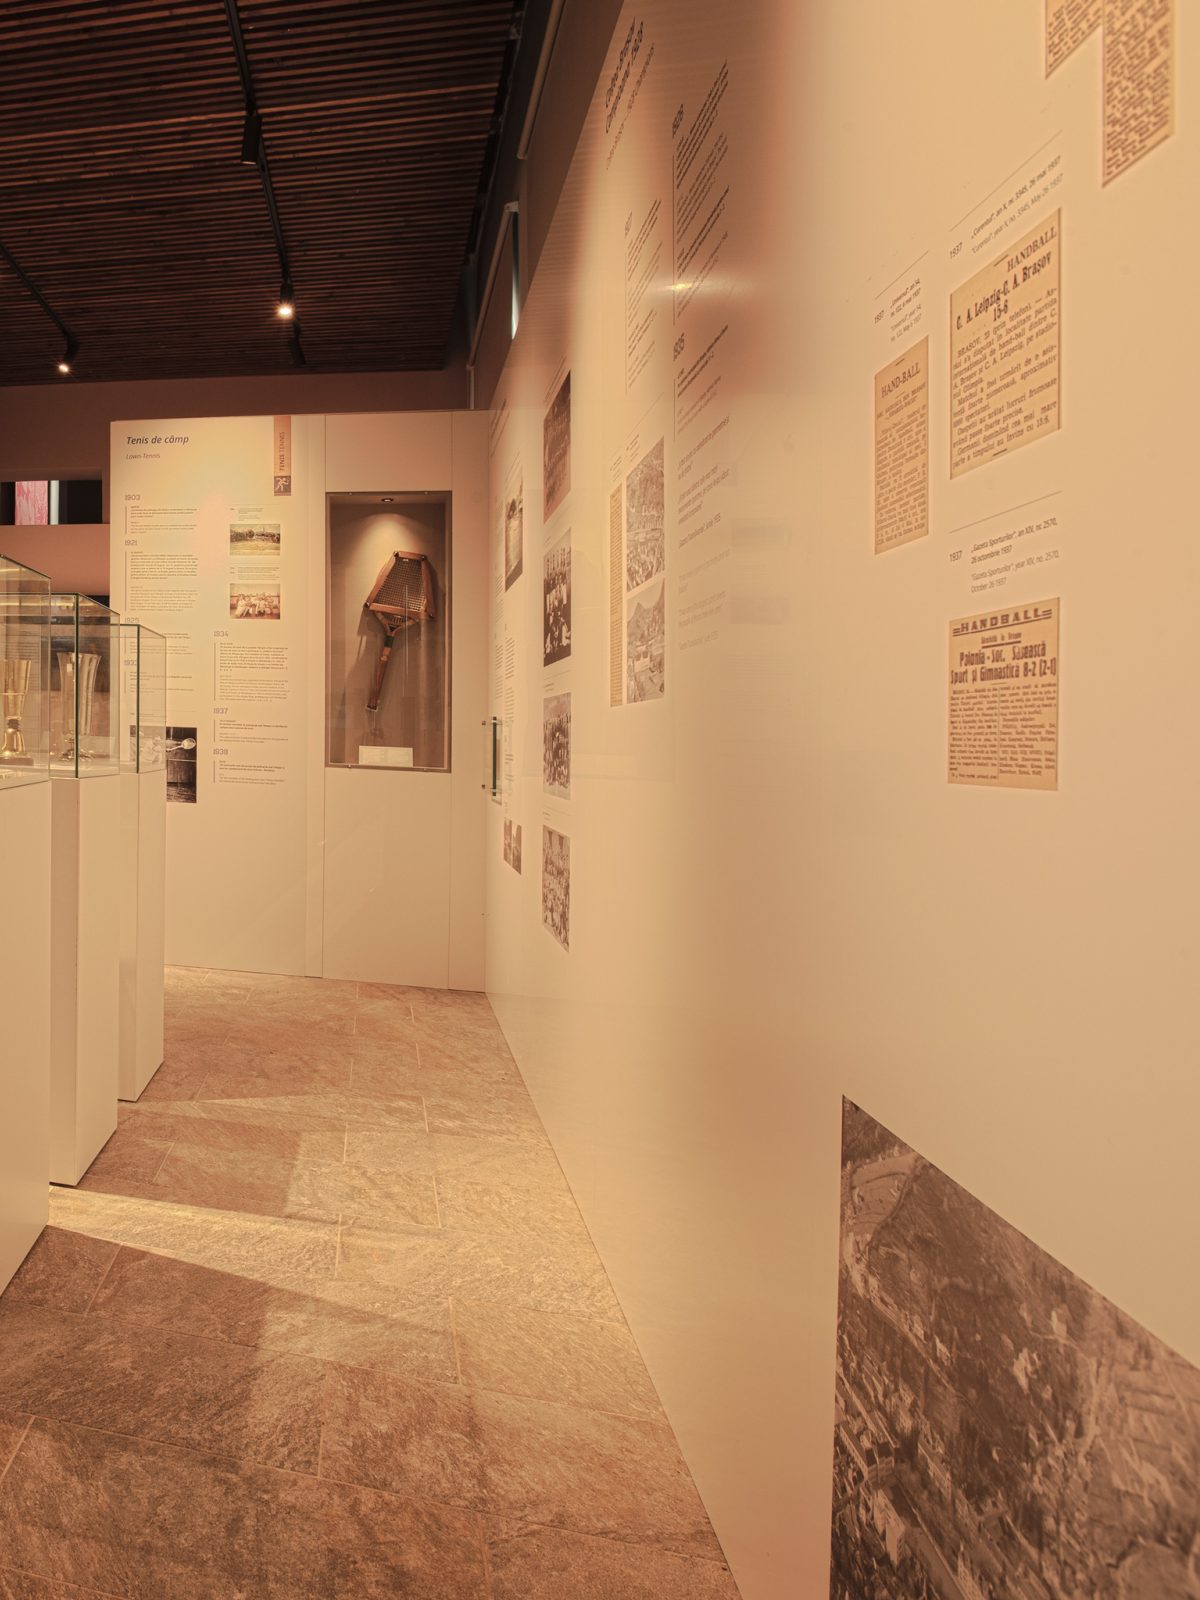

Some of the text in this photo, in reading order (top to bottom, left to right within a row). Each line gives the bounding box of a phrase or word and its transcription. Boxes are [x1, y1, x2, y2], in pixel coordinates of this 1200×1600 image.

[1007, 226, 1056, 271] HANDBALL
[881, 362, 920, 397] HAND-BALL
[127, 434, 189, 445] Tenis de câmp
[960, 608, 1041, 632] HANDBALL
